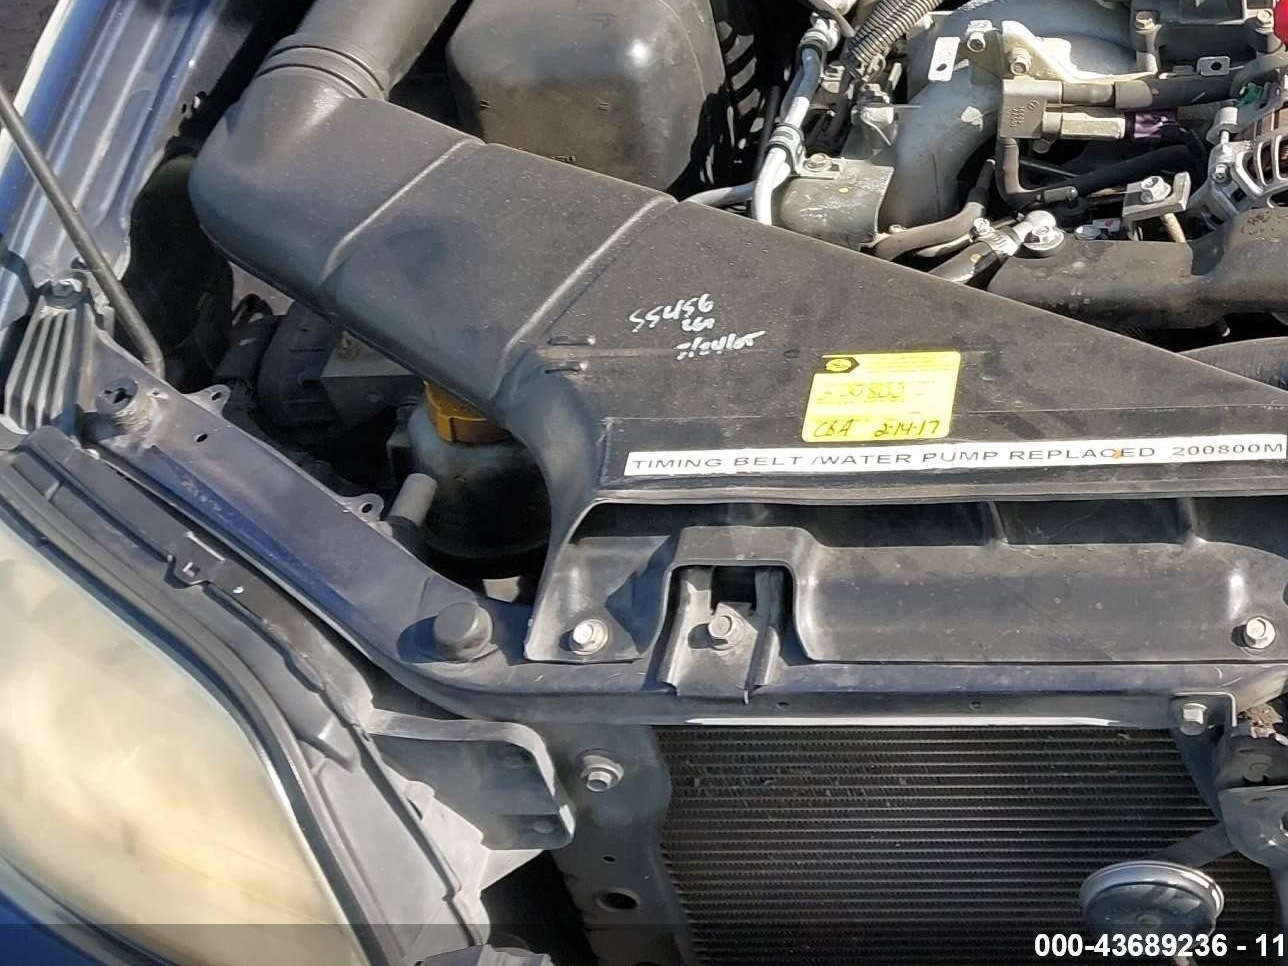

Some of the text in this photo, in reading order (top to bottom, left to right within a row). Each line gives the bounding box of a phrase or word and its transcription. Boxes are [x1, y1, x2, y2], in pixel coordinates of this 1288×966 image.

[873, 419, 941, 438] 2-14-17
[631, 442, 1284, 469] TIMING BELT /WATER PUMP REPLACED 200800M
